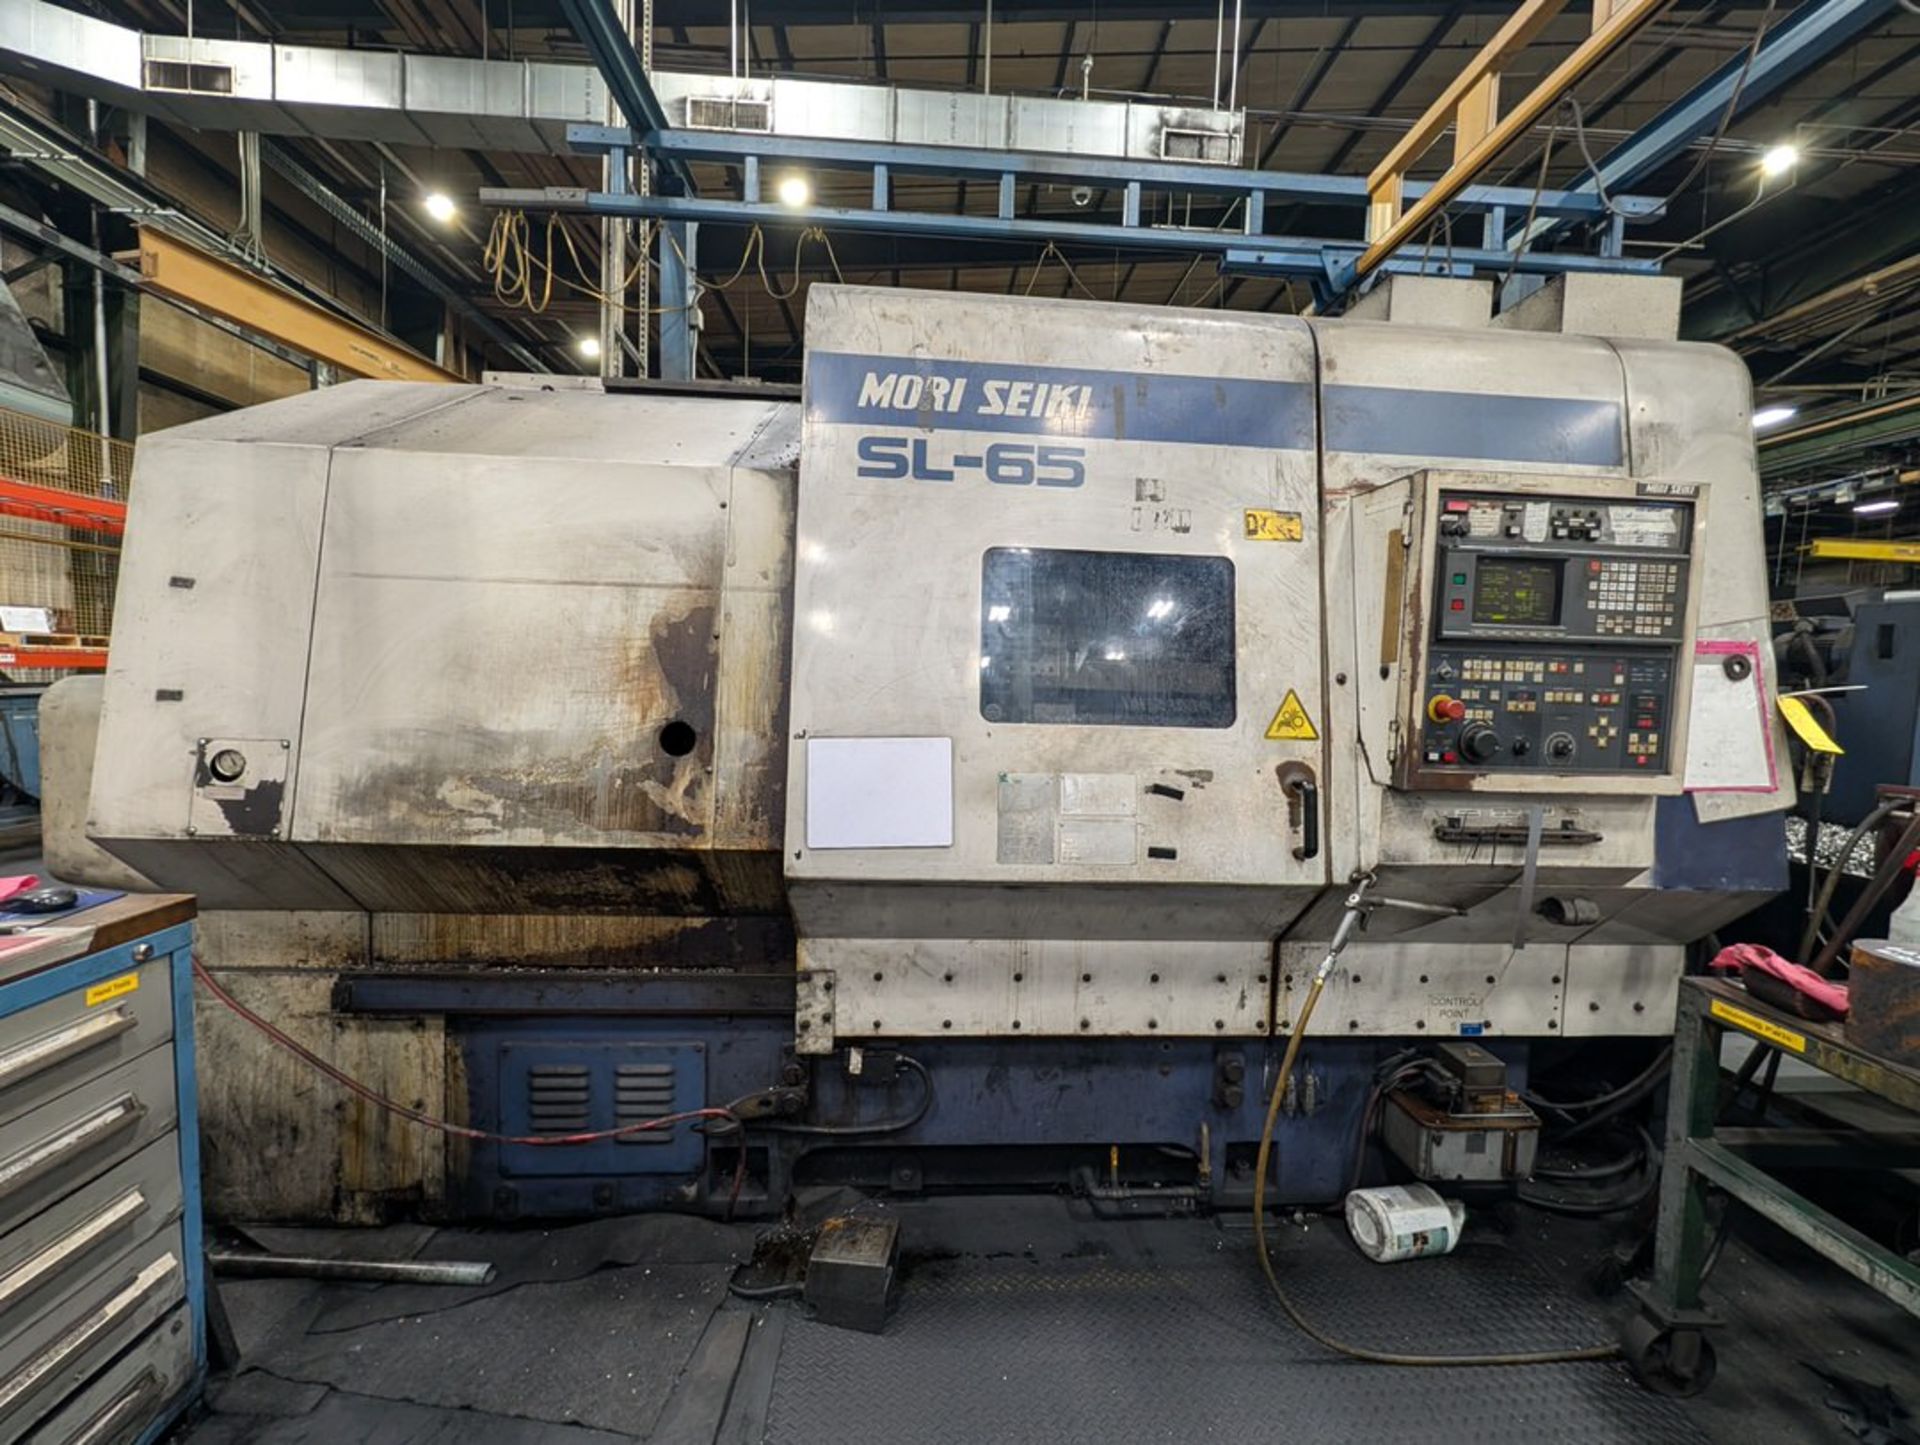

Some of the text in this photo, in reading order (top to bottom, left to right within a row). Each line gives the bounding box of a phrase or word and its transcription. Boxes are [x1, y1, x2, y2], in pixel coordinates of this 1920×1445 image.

[858, 372, 1093, 420] MORI SEIKI
[857, 436, 1086, 488] SL-65
[1431, 996, 1483, 1007] CONTROL
[1440, 1008, 1469, 1018] POINT
